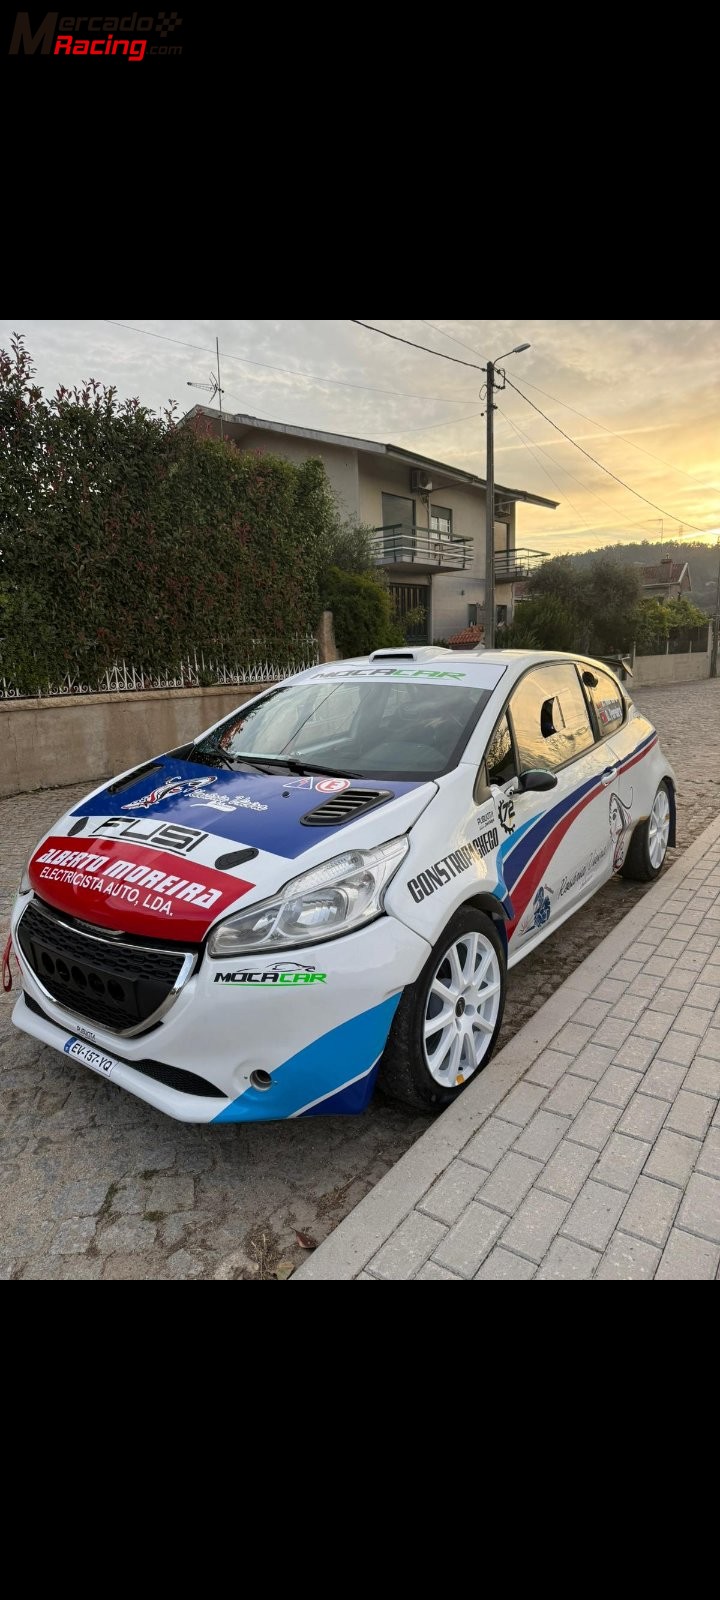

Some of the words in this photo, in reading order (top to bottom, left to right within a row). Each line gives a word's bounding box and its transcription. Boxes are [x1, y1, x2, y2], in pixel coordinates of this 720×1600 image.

[311, 668, 466, 681] MOCACAR
[326, 779, 340, 790] E
[502, 800, 515, 822] 72
[92, 817, 209, 852] FUSI
[36, 849, 106, 871] ALBERTO
[102, 860, 223, 909] MOREIRA
[40, 867, 104, 893] ELECTRICISTA
[105, 882, 140, 906] AUTO,
[143, 894, 173, 916] LDA.
[213, 972, 327, 984] MOCACAR
[71, 1043, 113, 1071] EV-157-YQ
